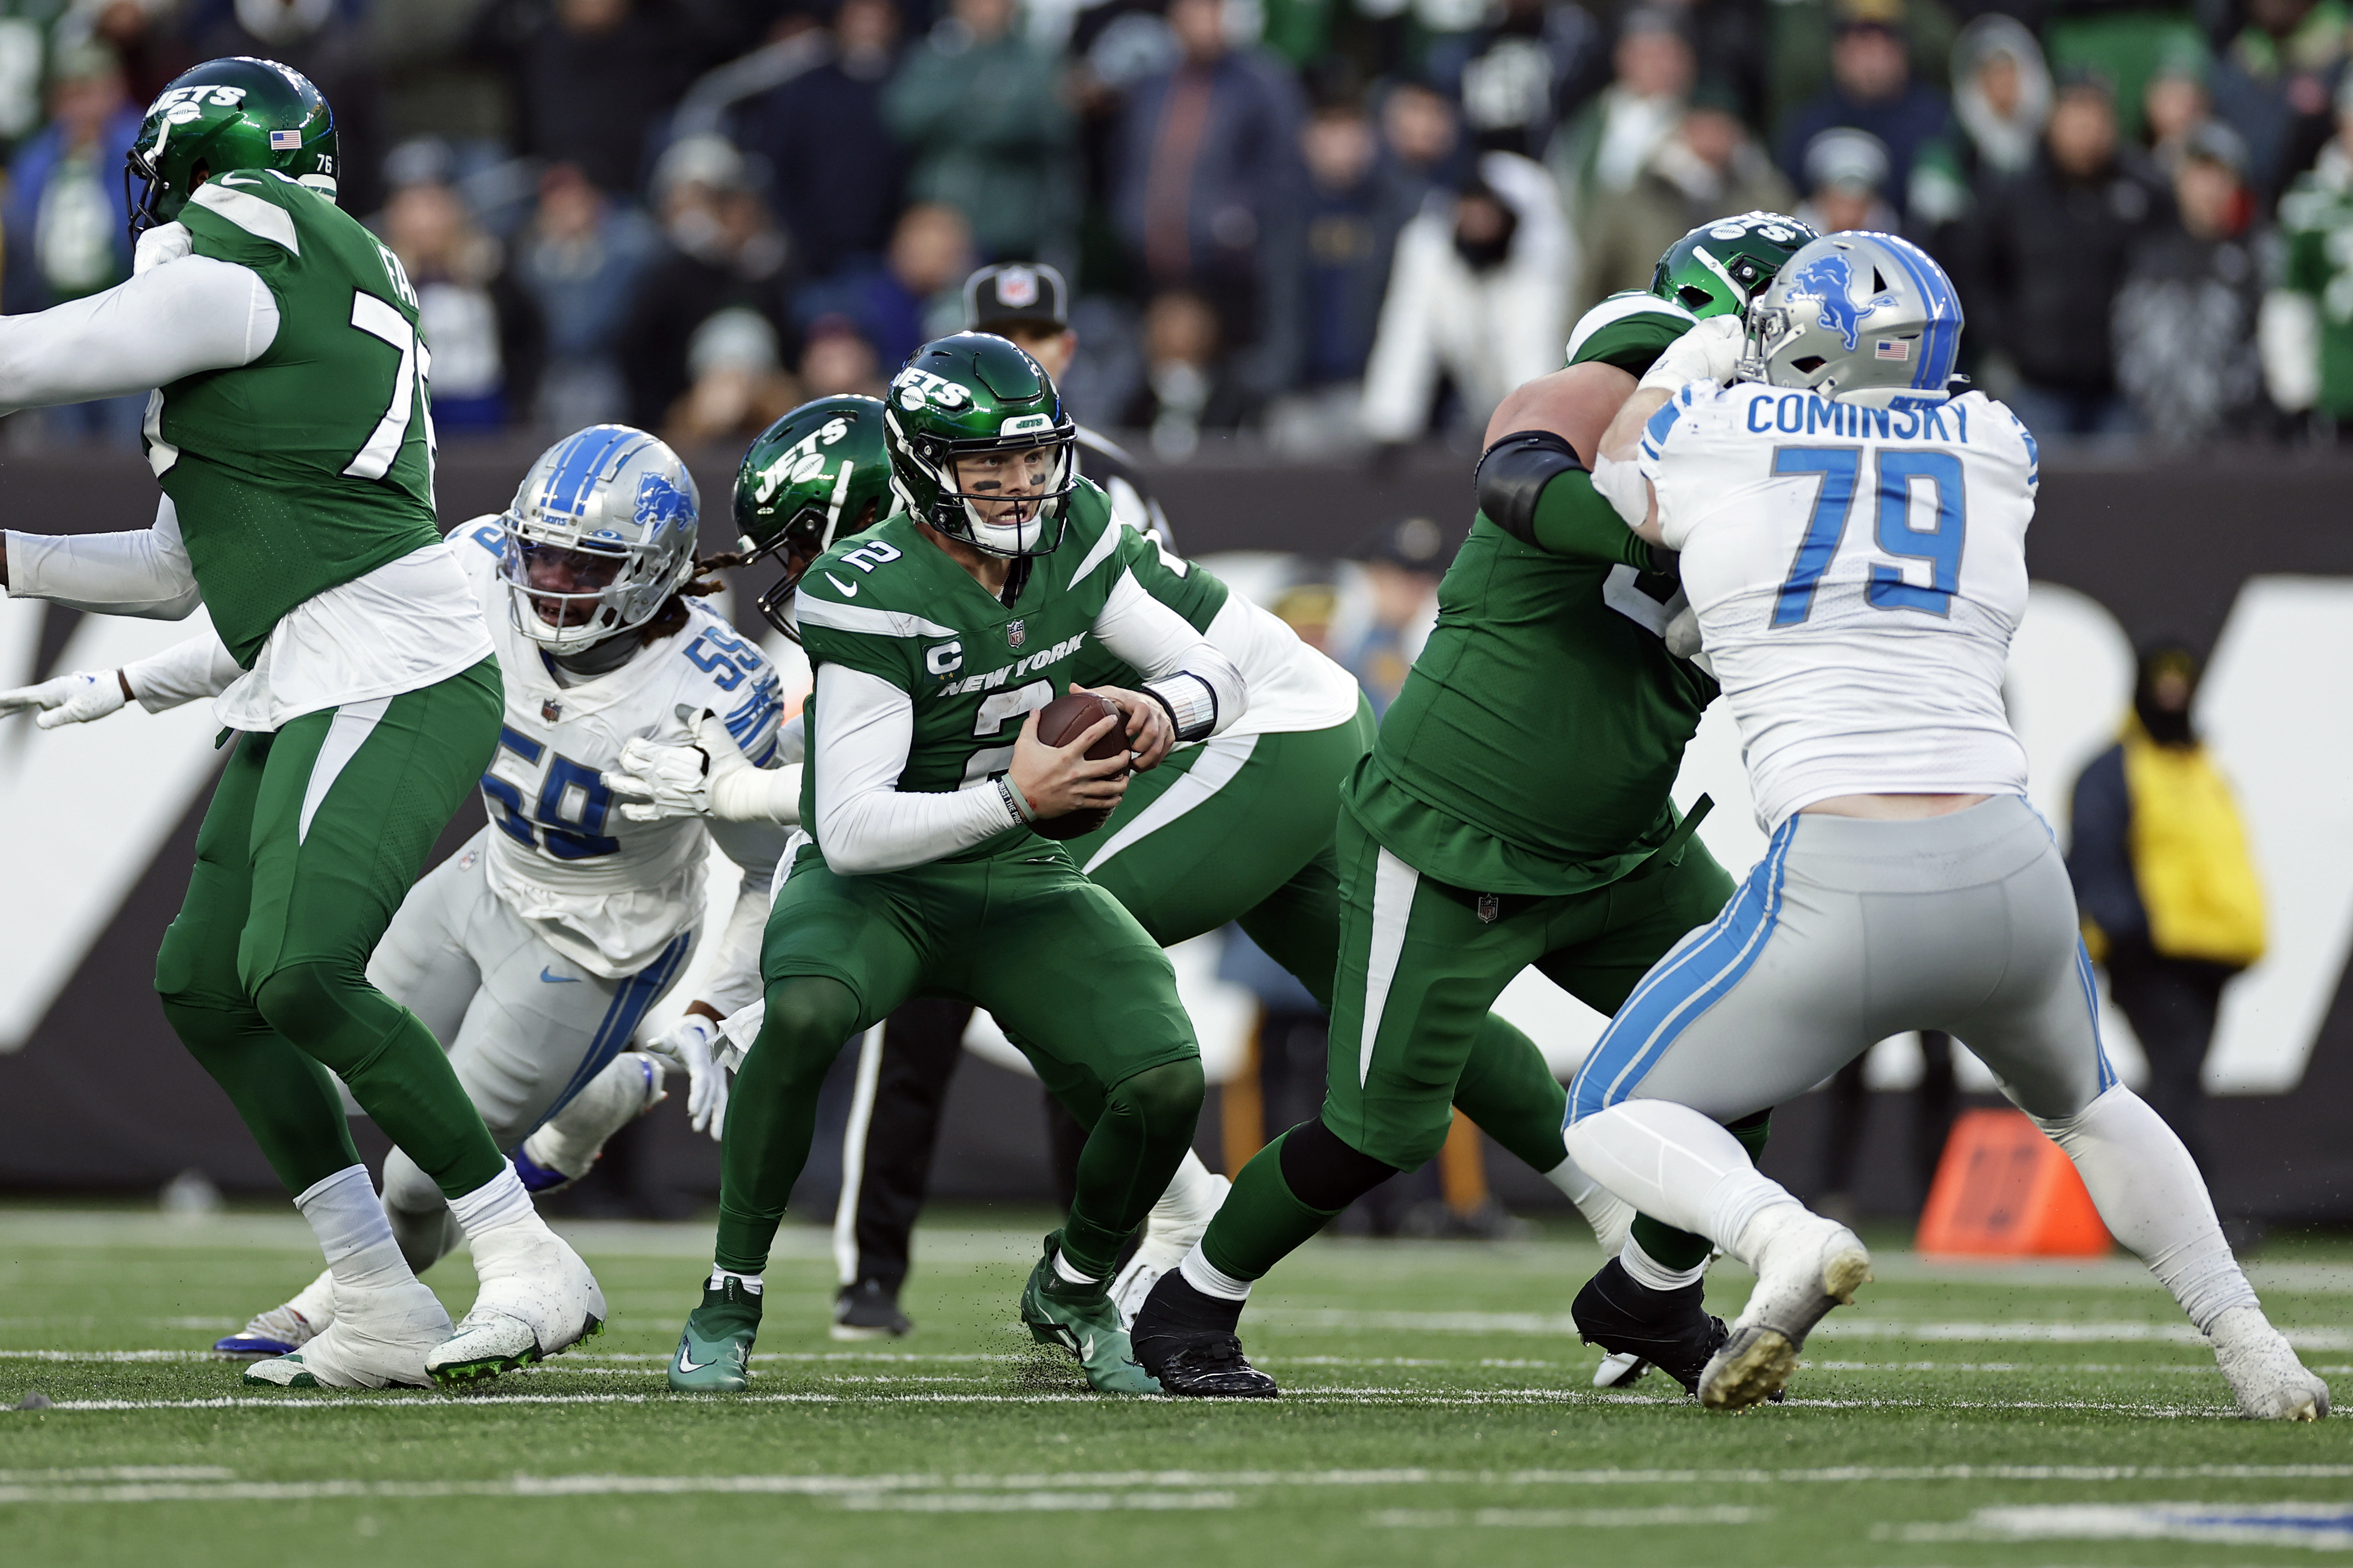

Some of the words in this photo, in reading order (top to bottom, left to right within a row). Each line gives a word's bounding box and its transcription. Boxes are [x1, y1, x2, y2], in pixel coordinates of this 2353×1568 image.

[146, 85, 247, 118] JETS
[316, 153, 333, 174] 76
[892, 366, 972, 407] JETS
[1016, 418, 1043, 429] JETS
[1747, 393, 1968, 444] COMINSKY
[755, 417, 848, 504] JETS
[1768, 445, 1967, 630] 79
[837, 540, 903, 575] 2
[1010, 632, 1023, 644] NFL
[682, 626, 764, 692] 59
[926, 641, 963, 675] C
[936, 664, 1015, 698] NEW
[1015, 630, 1088, 678] YORK
[479, 722, 621, 860] 59
[998, 780, 1011, 799] TRUST
[1005, 798, 1017, 812] THE
